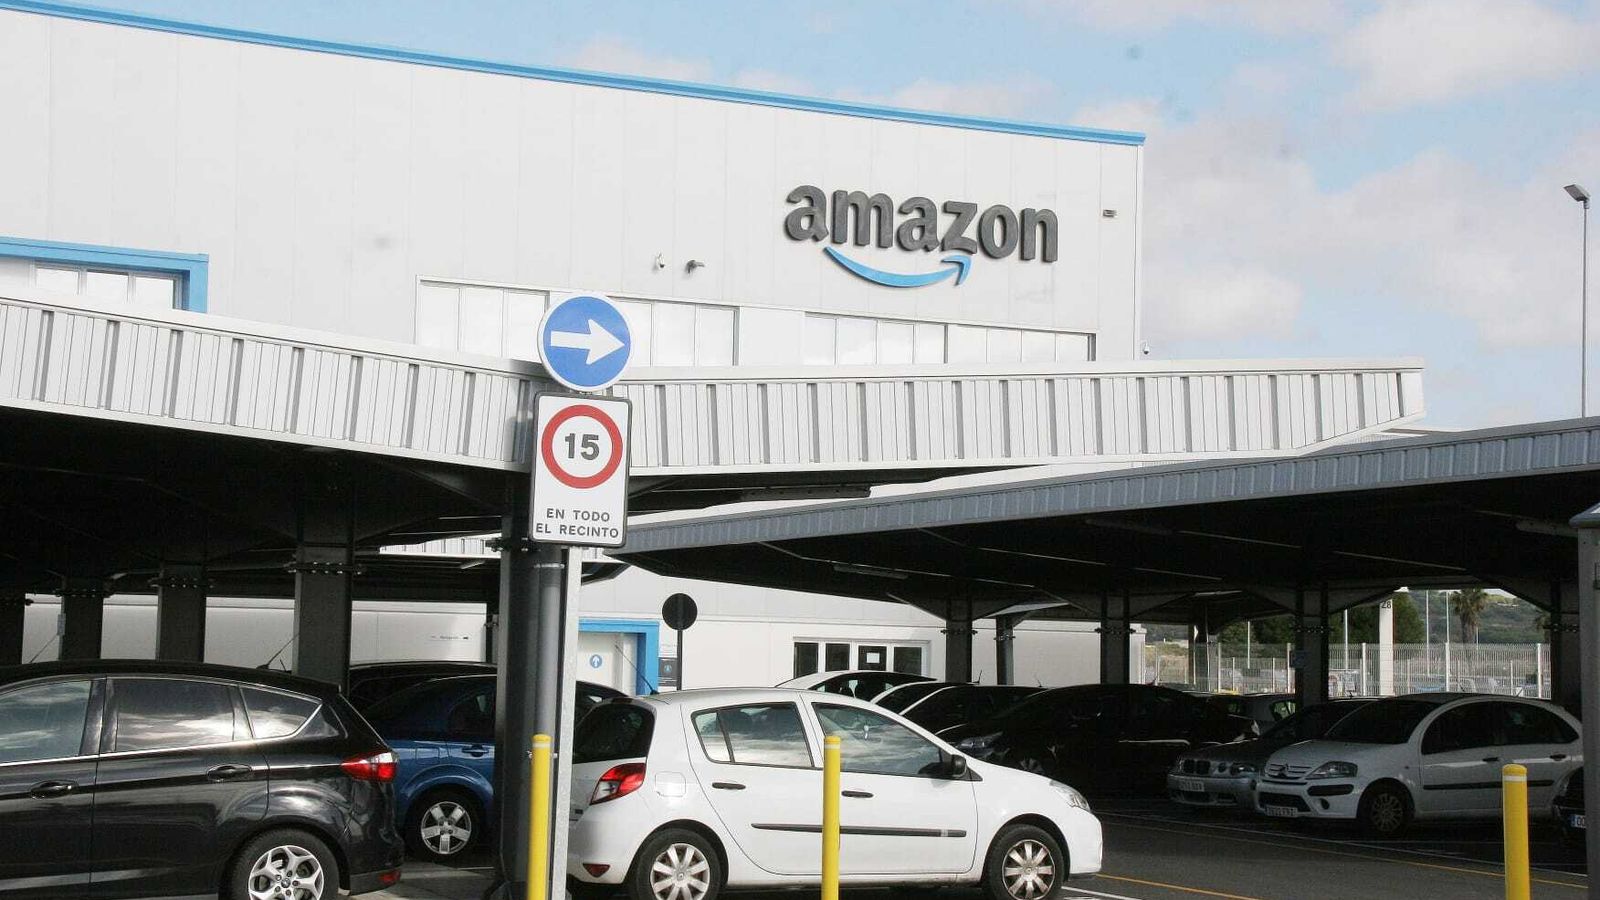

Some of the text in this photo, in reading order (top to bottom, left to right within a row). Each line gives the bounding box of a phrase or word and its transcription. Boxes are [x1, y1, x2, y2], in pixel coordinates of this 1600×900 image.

[785, 185, 1059, 263] amazon
[565, 432, 600, 461] 15
[546, 508, 610, 522] EN TODO
[536, 523, 619, 538] EL RECINTO
